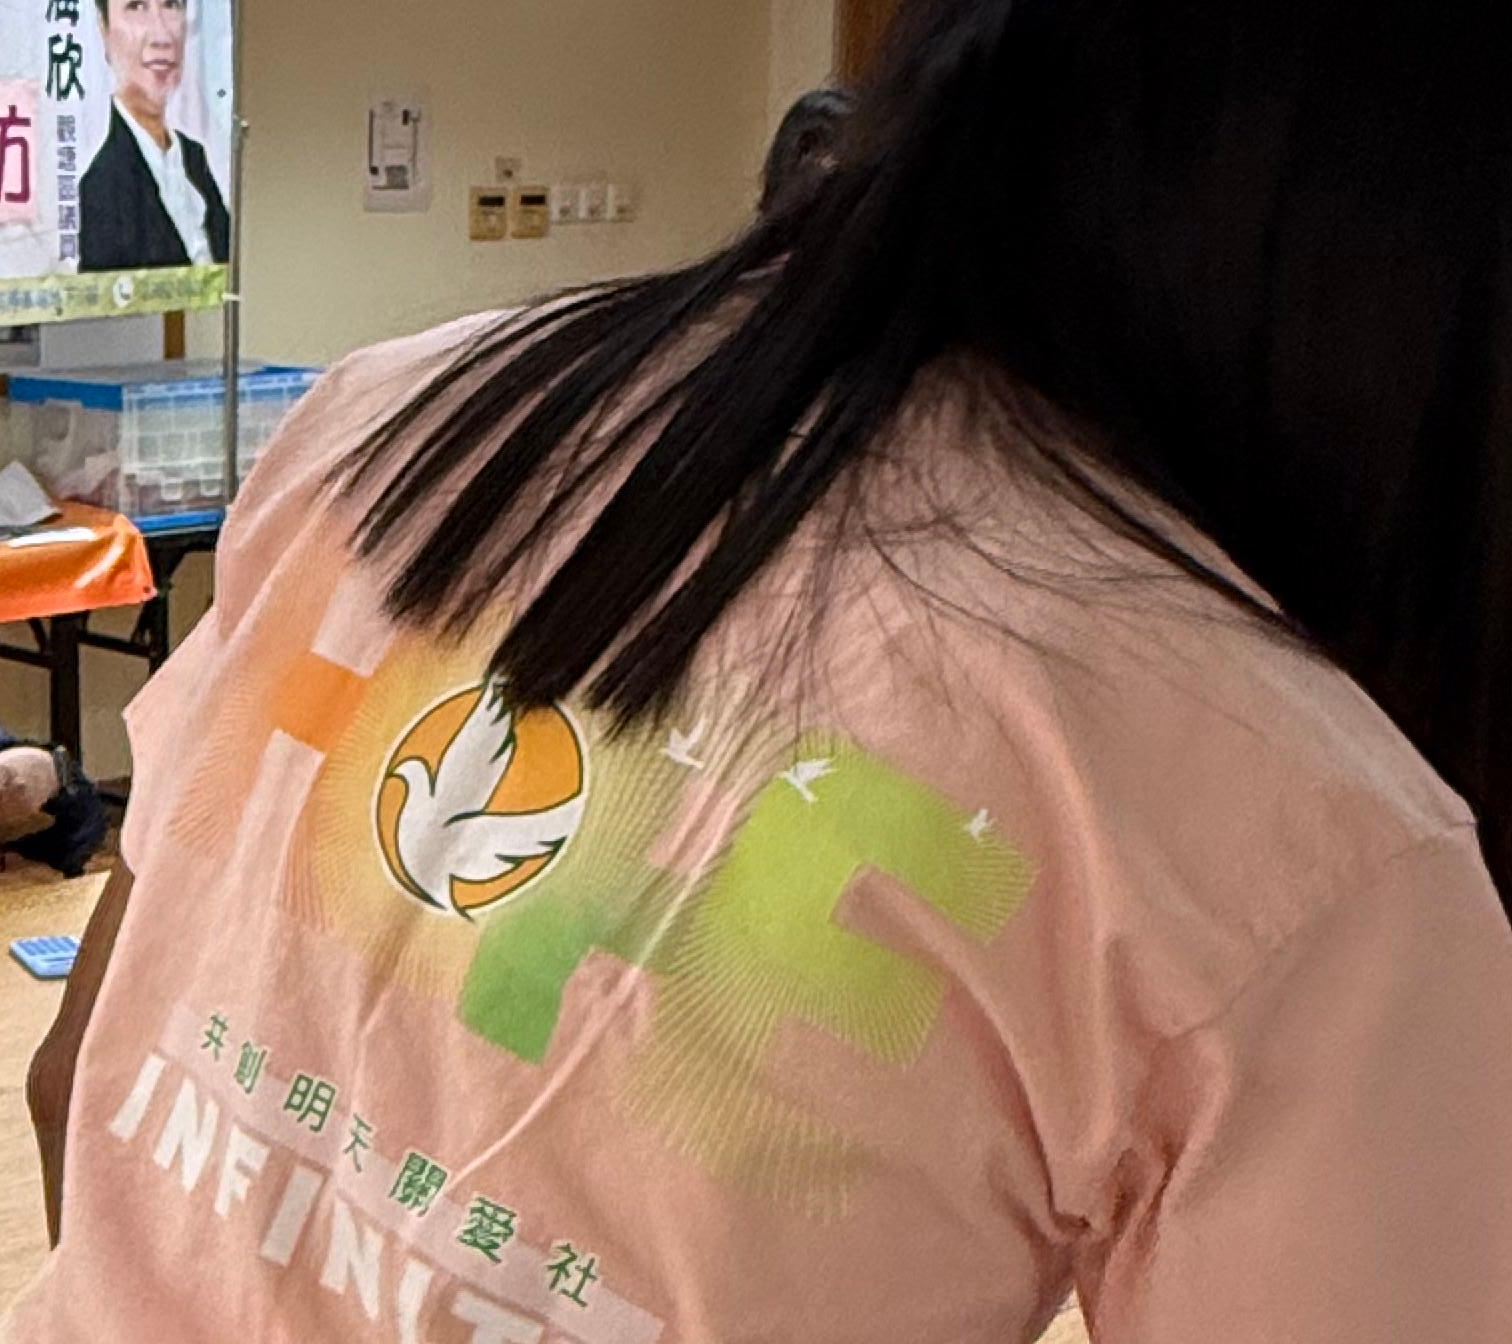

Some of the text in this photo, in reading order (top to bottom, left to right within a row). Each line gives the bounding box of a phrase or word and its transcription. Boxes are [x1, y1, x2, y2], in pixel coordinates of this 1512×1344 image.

[201, 1012, 597, 1308] 共創明天關愛社
